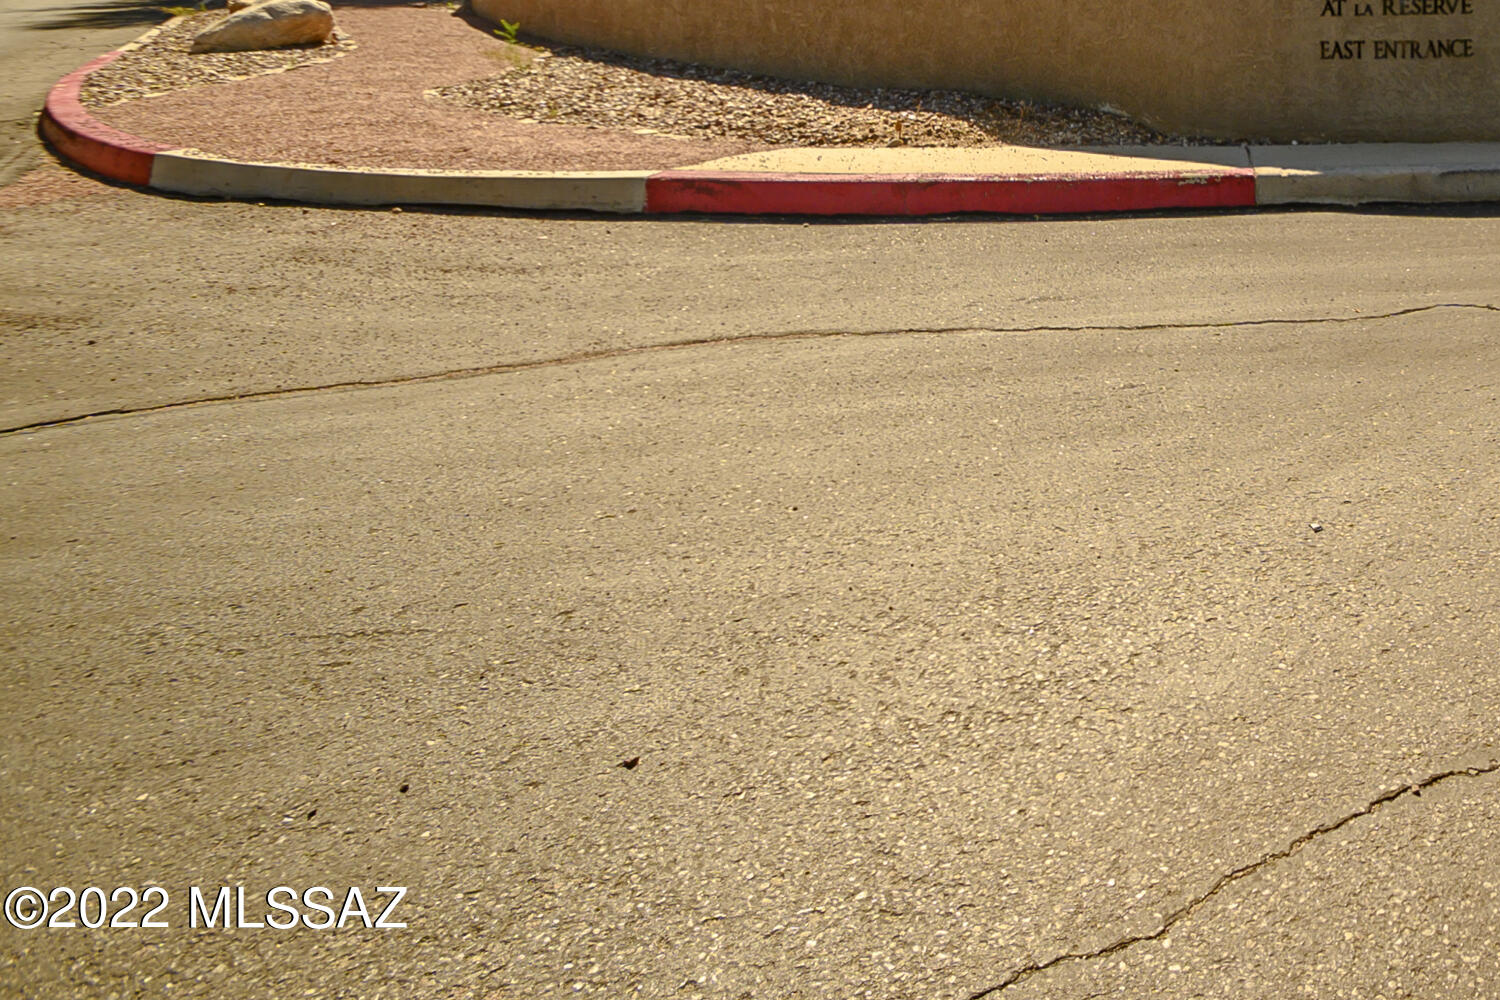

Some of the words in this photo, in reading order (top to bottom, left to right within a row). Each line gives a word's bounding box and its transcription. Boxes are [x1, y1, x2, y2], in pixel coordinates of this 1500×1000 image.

[1320, 0, 1346, 17] AT
[1354, 3, 1373, 17] LA
[1320, 41, 1365, 60] EAST
[1374, 39, 1474, 60] ENTRANCE
